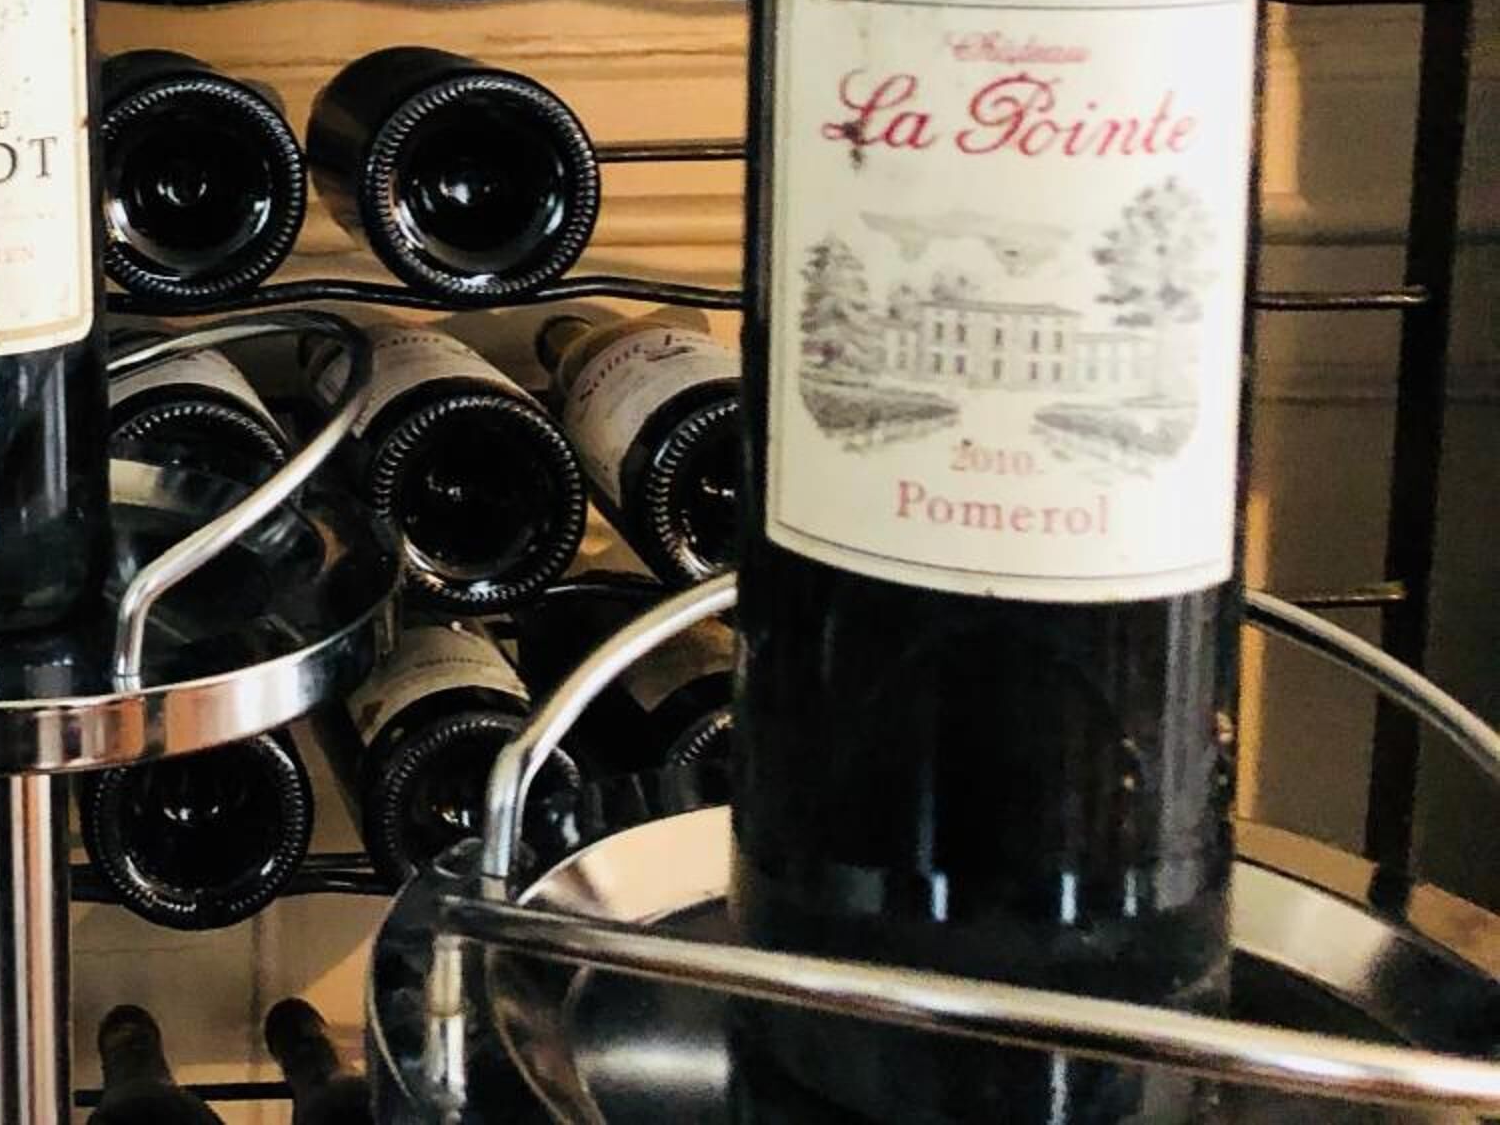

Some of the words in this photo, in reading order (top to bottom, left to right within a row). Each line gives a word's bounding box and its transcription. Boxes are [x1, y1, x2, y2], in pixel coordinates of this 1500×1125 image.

[820, 69, 938, 153] La
[953, 70, 1200, 158] Pointe
[949, 442, 1036, 476] 2010
[896, 479, 1110, 535] Pomerol
